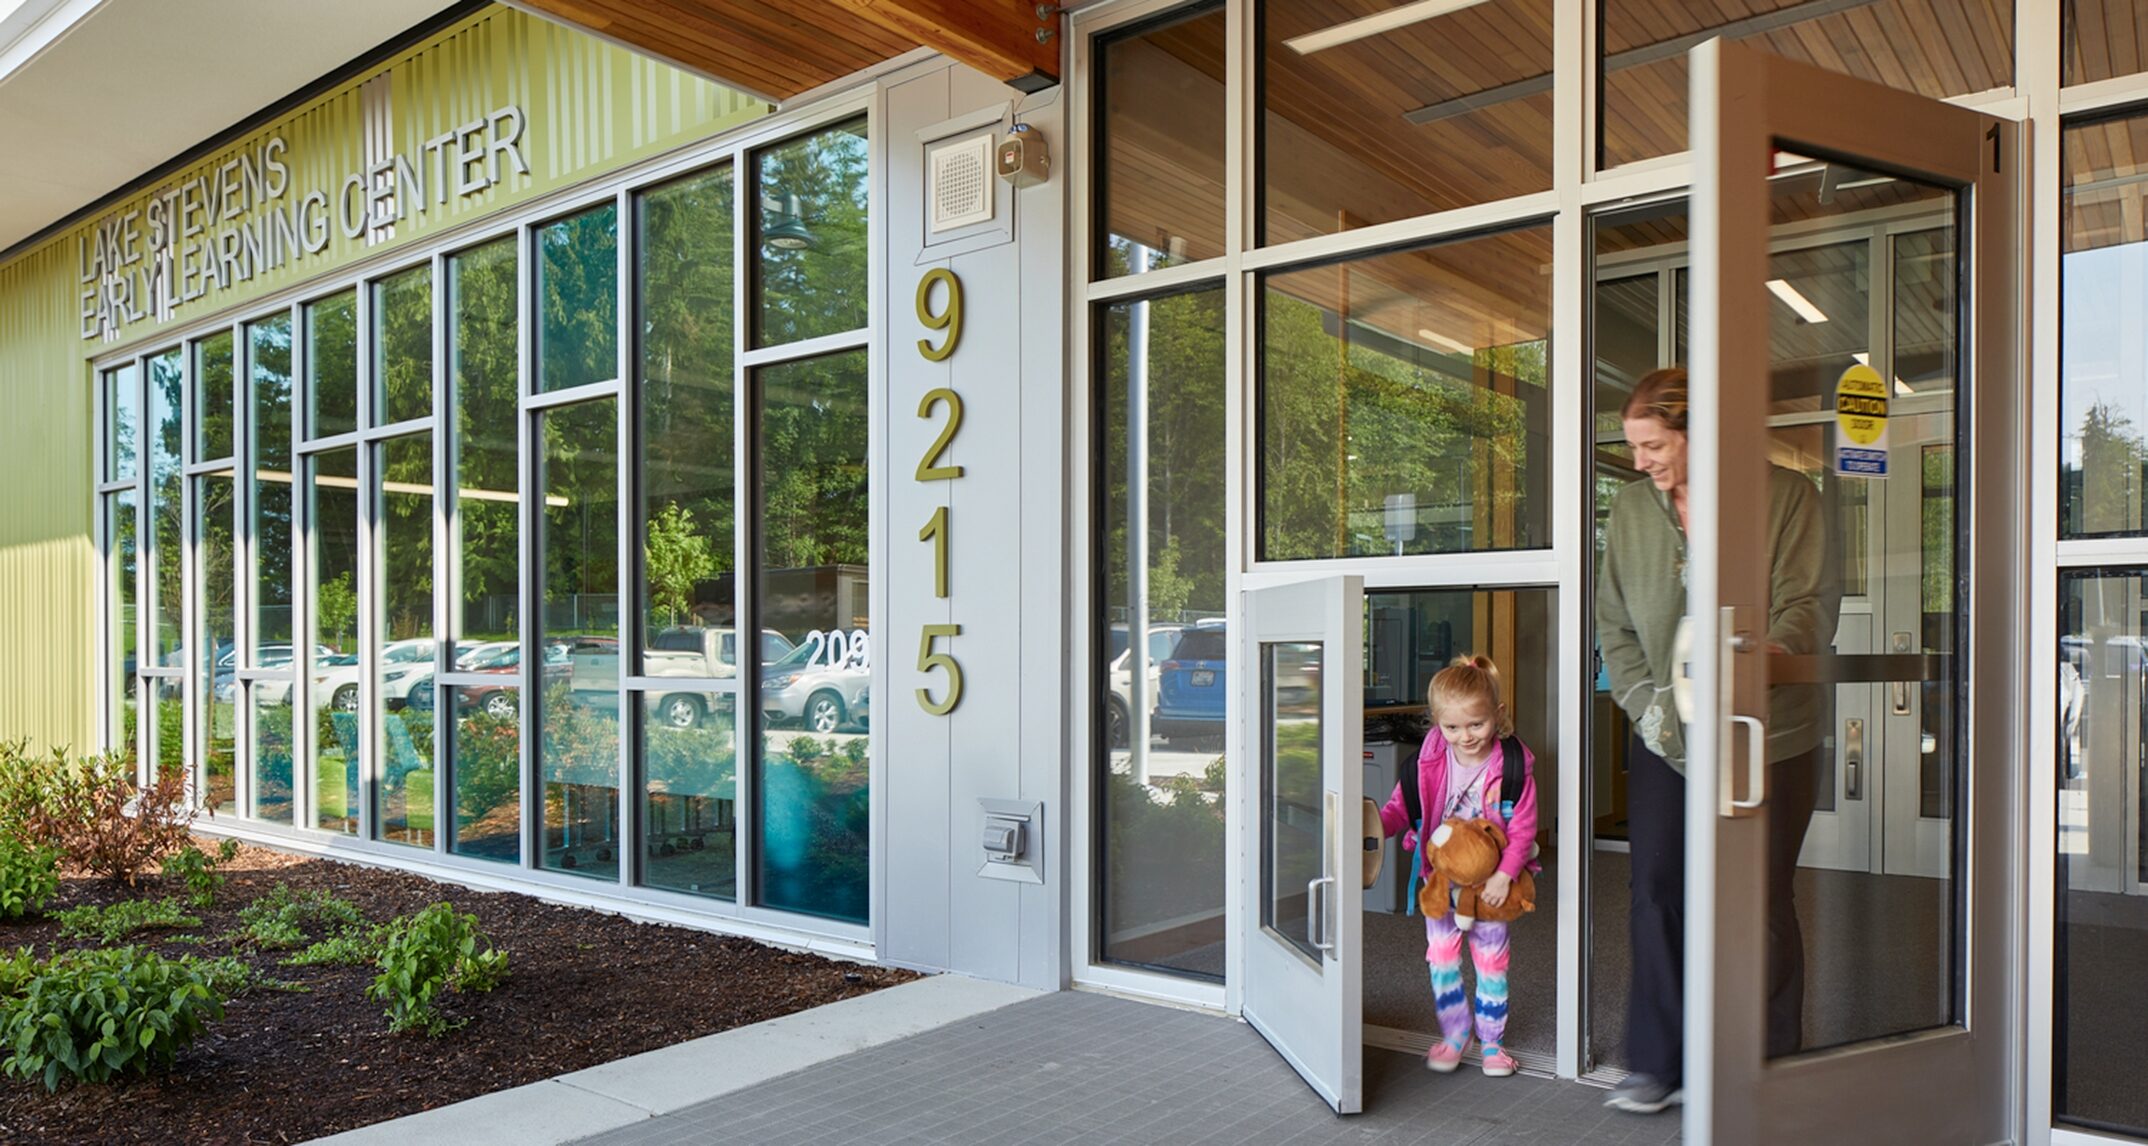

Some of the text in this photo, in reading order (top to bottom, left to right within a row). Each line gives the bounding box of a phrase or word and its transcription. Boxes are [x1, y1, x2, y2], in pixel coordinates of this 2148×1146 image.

[1986, 122, 2001, 174] 1
[80, 137, 289, 284] LAKE STEVENS
[81, 105, 529, 340] EARLY LEARNING CENTER
[1838, 395, 1887, 416] CAUTION
